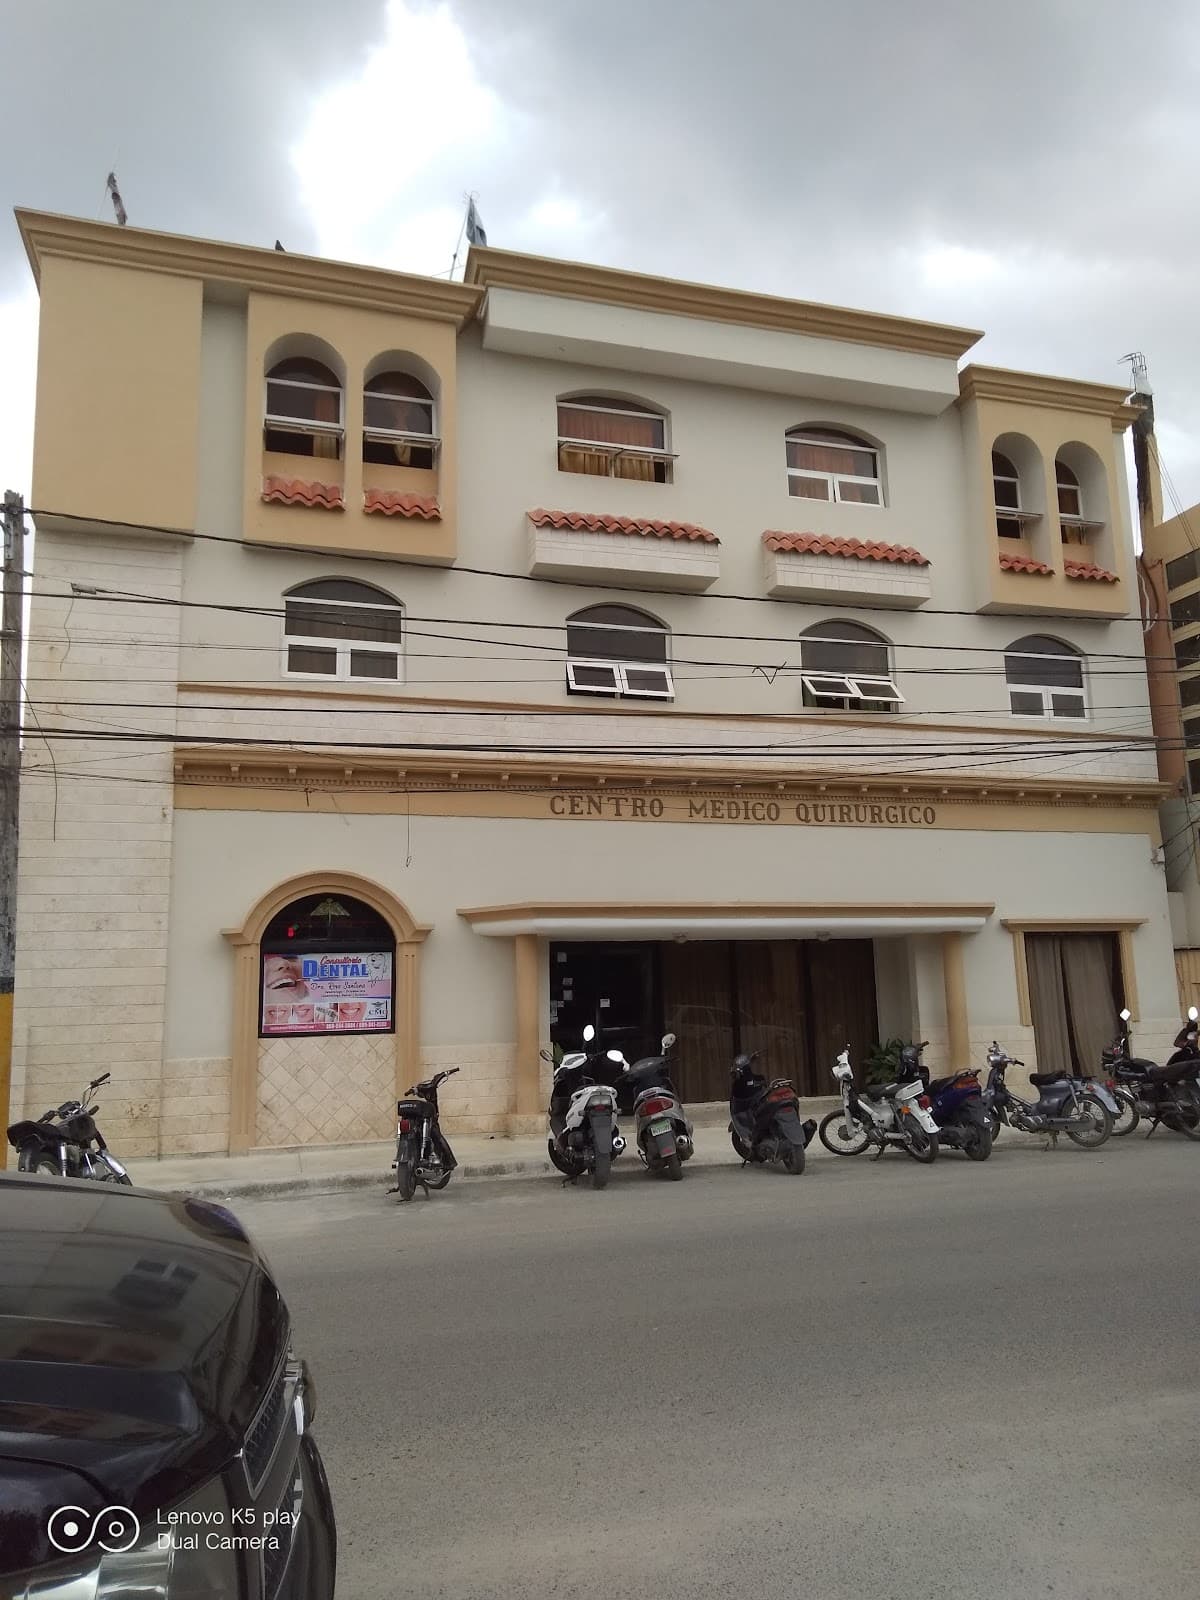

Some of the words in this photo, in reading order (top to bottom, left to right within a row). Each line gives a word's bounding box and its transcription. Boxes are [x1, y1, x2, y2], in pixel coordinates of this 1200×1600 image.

[549, 794, 664, 818] CENTRO
[687, 798, 780, 822] MEDICO
[795, 802, 936, 825] QUIRURGICO
[303, 960, 368, 977] DENTAL
